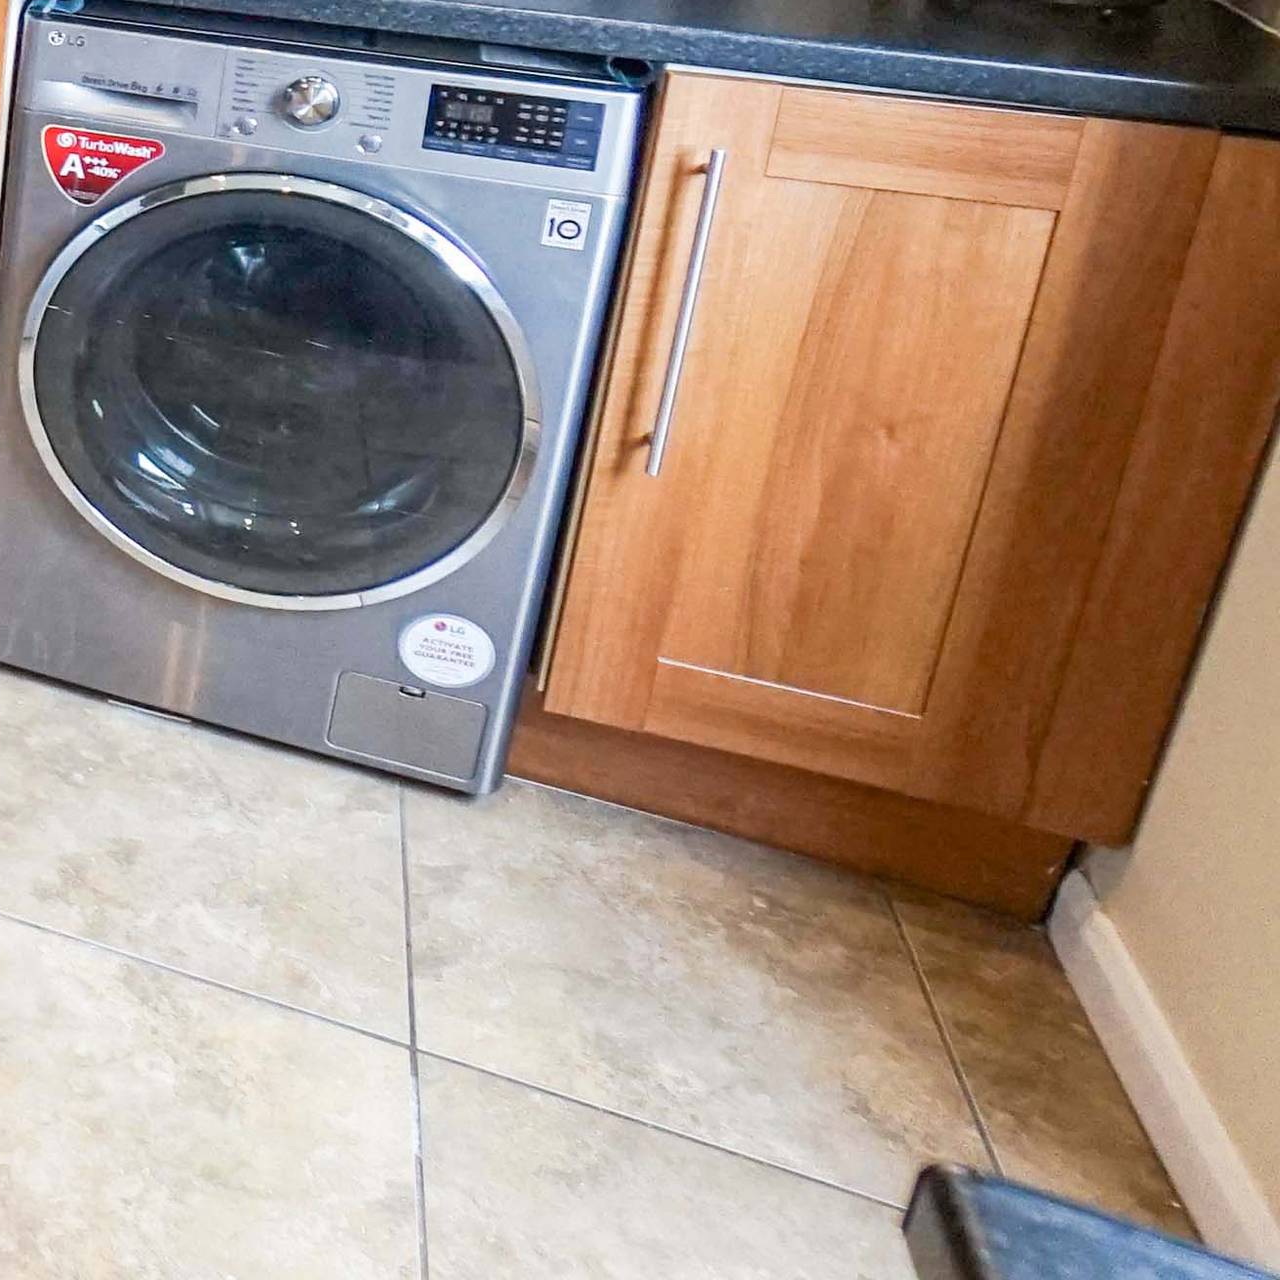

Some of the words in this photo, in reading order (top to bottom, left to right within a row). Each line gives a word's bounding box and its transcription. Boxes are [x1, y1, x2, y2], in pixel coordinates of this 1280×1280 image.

[67, 34, 86, 47] LG
[107, 78, 130, 90] Drive
[548, 217, 582, 240] 10
[449, 626, 466, 635] LG
[423, 637, 474, 654] ACTIVATE
